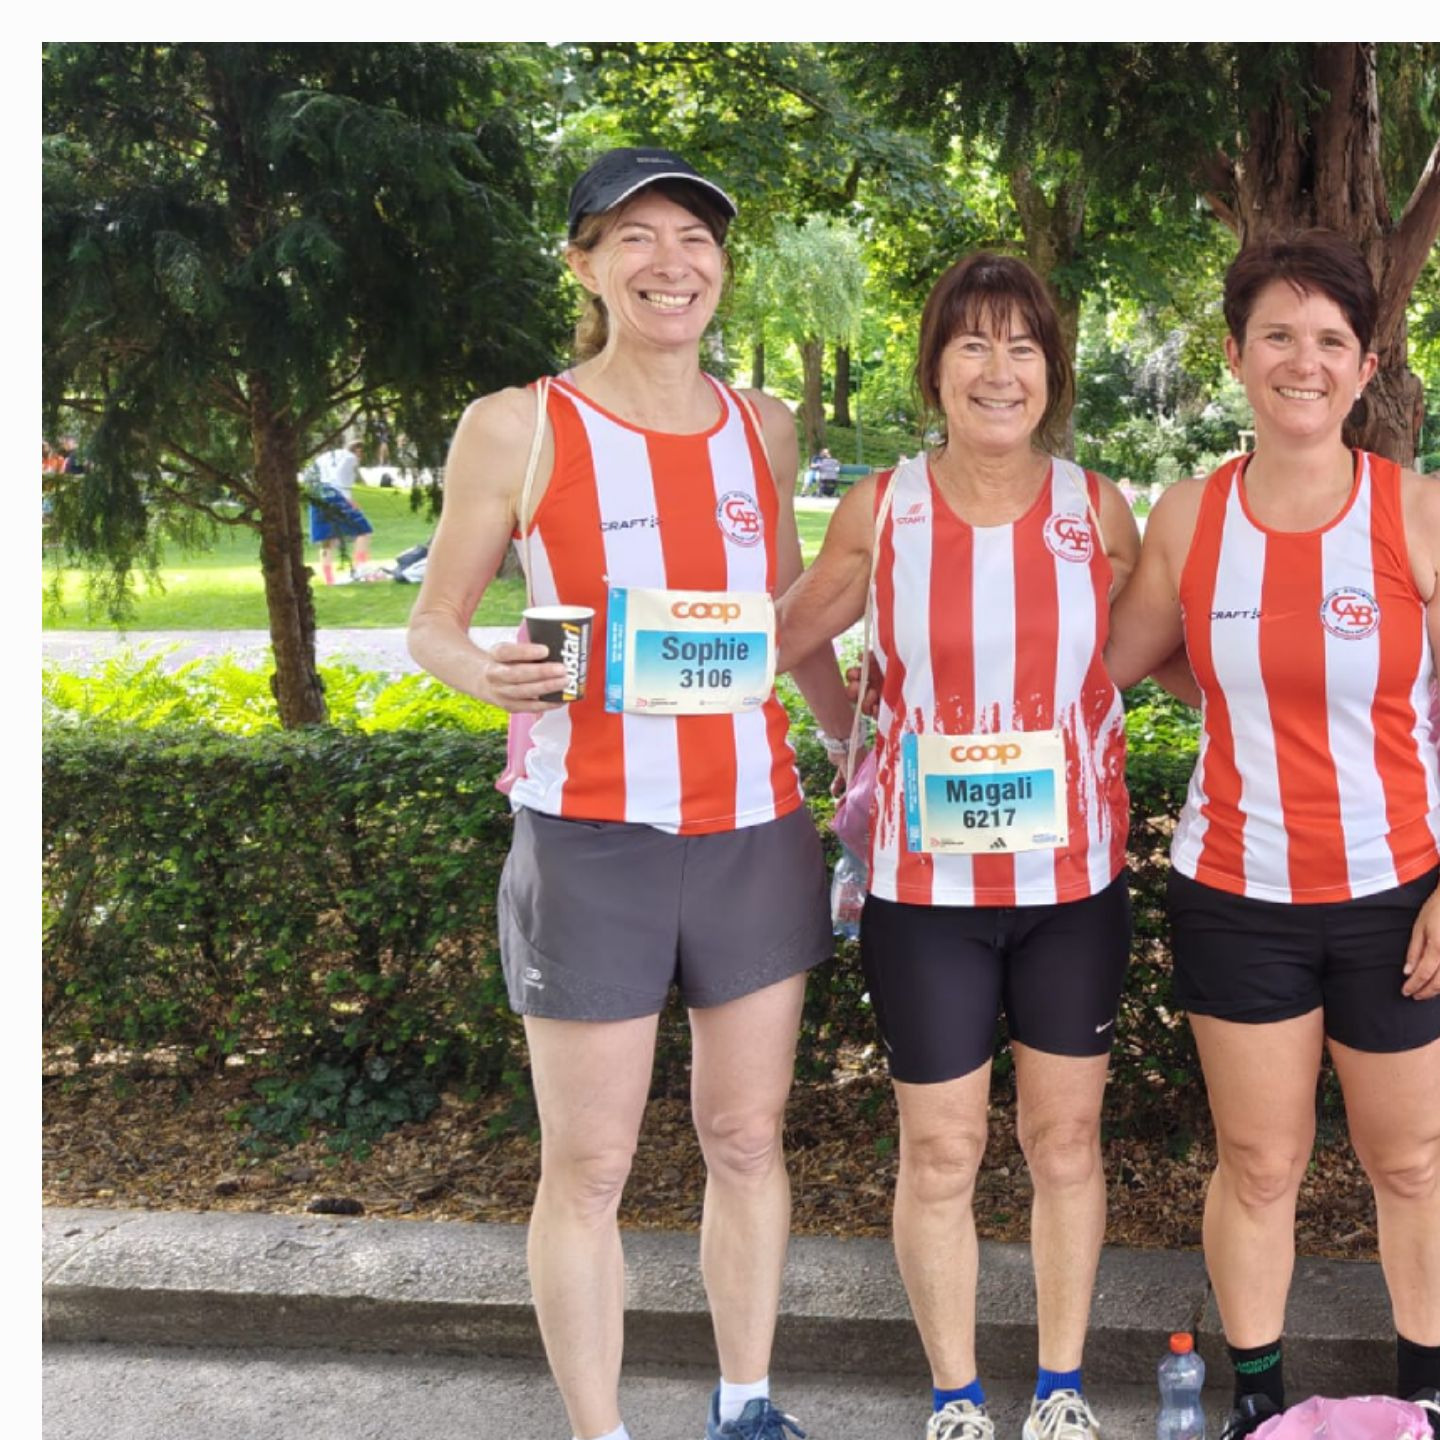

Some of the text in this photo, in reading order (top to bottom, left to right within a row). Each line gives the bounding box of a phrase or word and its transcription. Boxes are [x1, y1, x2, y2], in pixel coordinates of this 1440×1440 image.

[599, 518, 649, 532] CRAFT
[672, 602, 740, 624] coop
[1209, 610, 1250, 621] CRAFT
[1331, 595, 1373, 625] CAB
[662, 636, 748, 665] Sophie
[680, 669, 732, 688] 3106
[950, 743, 1021, 764] coop
[945, 777, 1032, 807] Magali
[963, 809, 1016, 828] 6217
